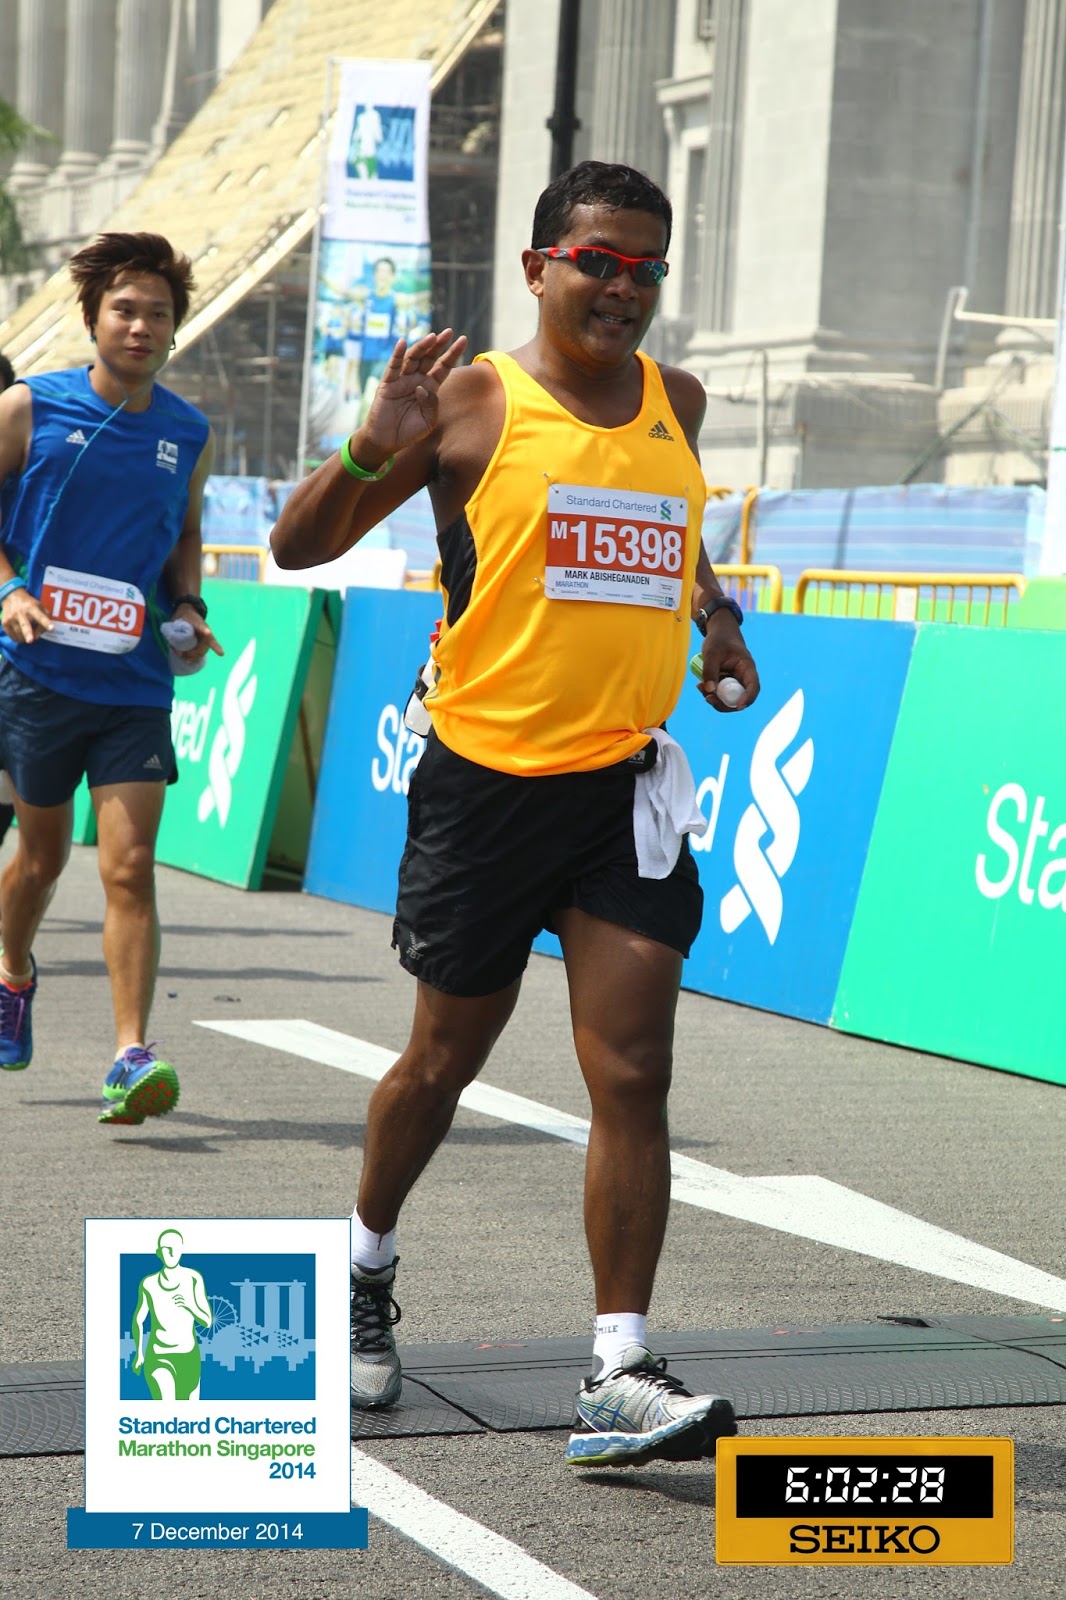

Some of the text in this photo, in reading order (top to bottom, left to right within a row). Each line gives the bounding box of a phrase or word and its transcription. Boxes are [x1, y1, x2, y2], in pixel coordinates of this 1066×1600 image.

[648, 431, 675, 442] adidas
[566, 494, 657, 513] Standard Chartered
[570, 520, 682, 573] 15398
[555, 580, 589, 589] MARATHON
[564, 570, 650, 585] MARK ABISHEGANADEN
[49, 589, 138, 632] 15029
[975, 782, 1066, 913] Sta
